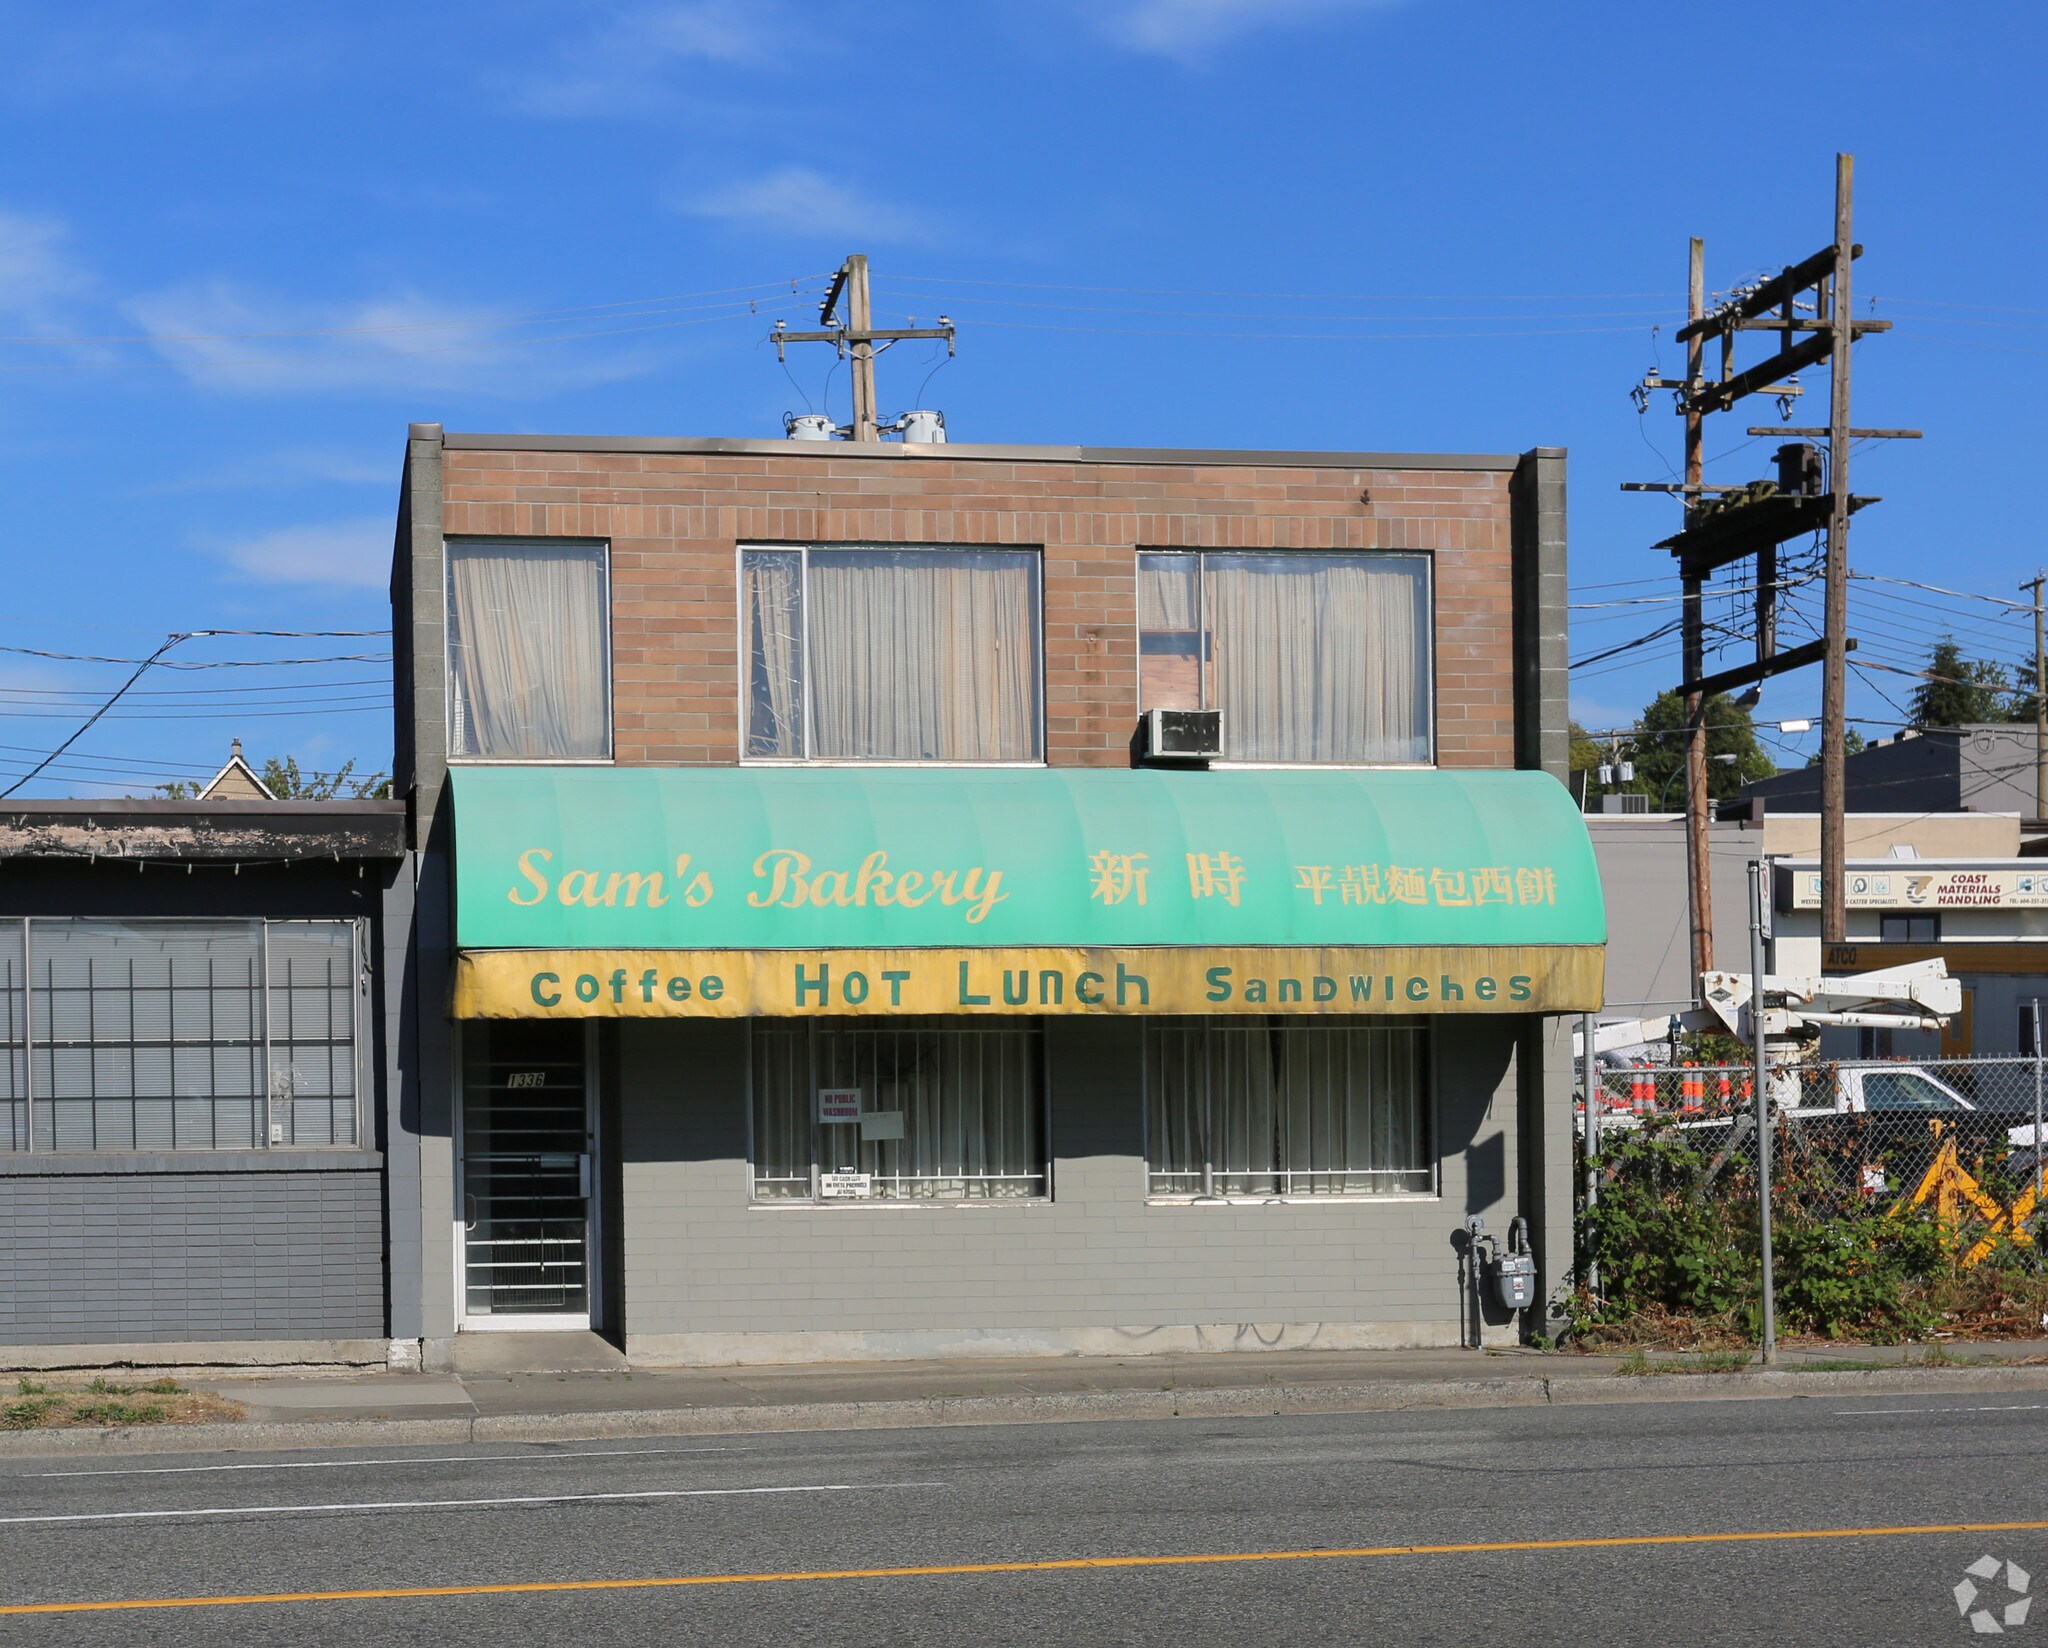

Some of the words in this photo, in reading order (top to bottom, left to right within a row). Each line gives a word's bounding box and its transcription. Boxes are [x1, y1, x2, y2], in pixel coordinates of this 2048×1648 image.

[1951, 874, 1988, 883] COAST
[508, 848, 714, 907] Sam's
[747, 849, 1010, 923] Bakery
[1937, 885, 2001, 894] MATERIALS
[1938, 895, 2001, 904] HANDLING
[1828, 946, 1857, 965] ATCO
[530, 968, 725, 1007] Coffee
[959, 961, 1150, 1006] Lunch
[510, 1073, 544, 1087] 1336
[834, 1094, 855, 1104] PUBLIC
[823, 1107, 858, 1117] WASHROOM
